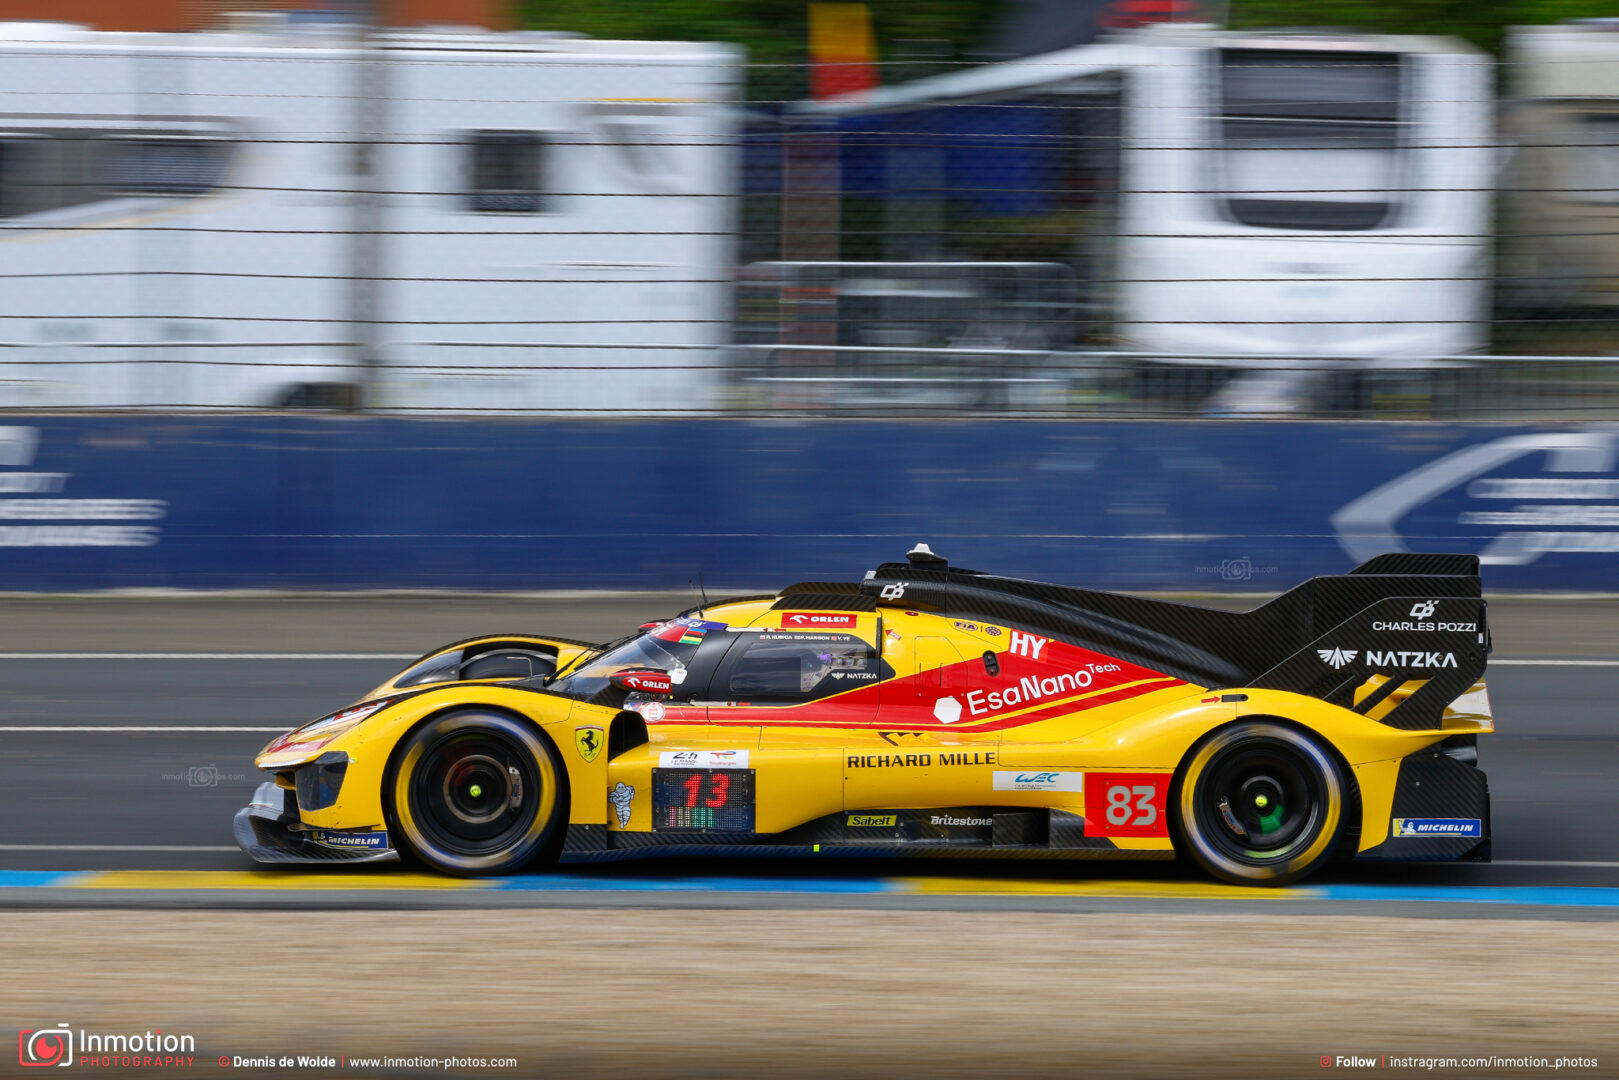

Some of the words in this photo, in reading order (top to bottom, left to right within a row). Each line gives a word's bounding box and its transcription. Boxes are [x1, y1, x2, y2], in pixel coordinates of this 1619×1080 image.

[955, 621, 976, 630] FIA
[1372, 621, 1435, 632] CHARLES
[1437, 622, 1477, 632] POZZI
[1010, 631, 1047, 659] HY
[1366, 651, 1458, 668] NATZKA
[642, 680, 669, 690] ORLEN
[847, 754, 931, 768] RICHARD
[939, 752, 996, 766] MILLE
[1015, 772, 1060, 783] WEC
[684, 773, 730, 809] 13
[1106, 785, 1156, 826] 83
[852, 816, 891, 826] Sabelt
[931, 814, 993, 826] Britestone
[1417, 824, 1474, 832] MICHELIN
[328, 836, 380, 845] MICHELIN
